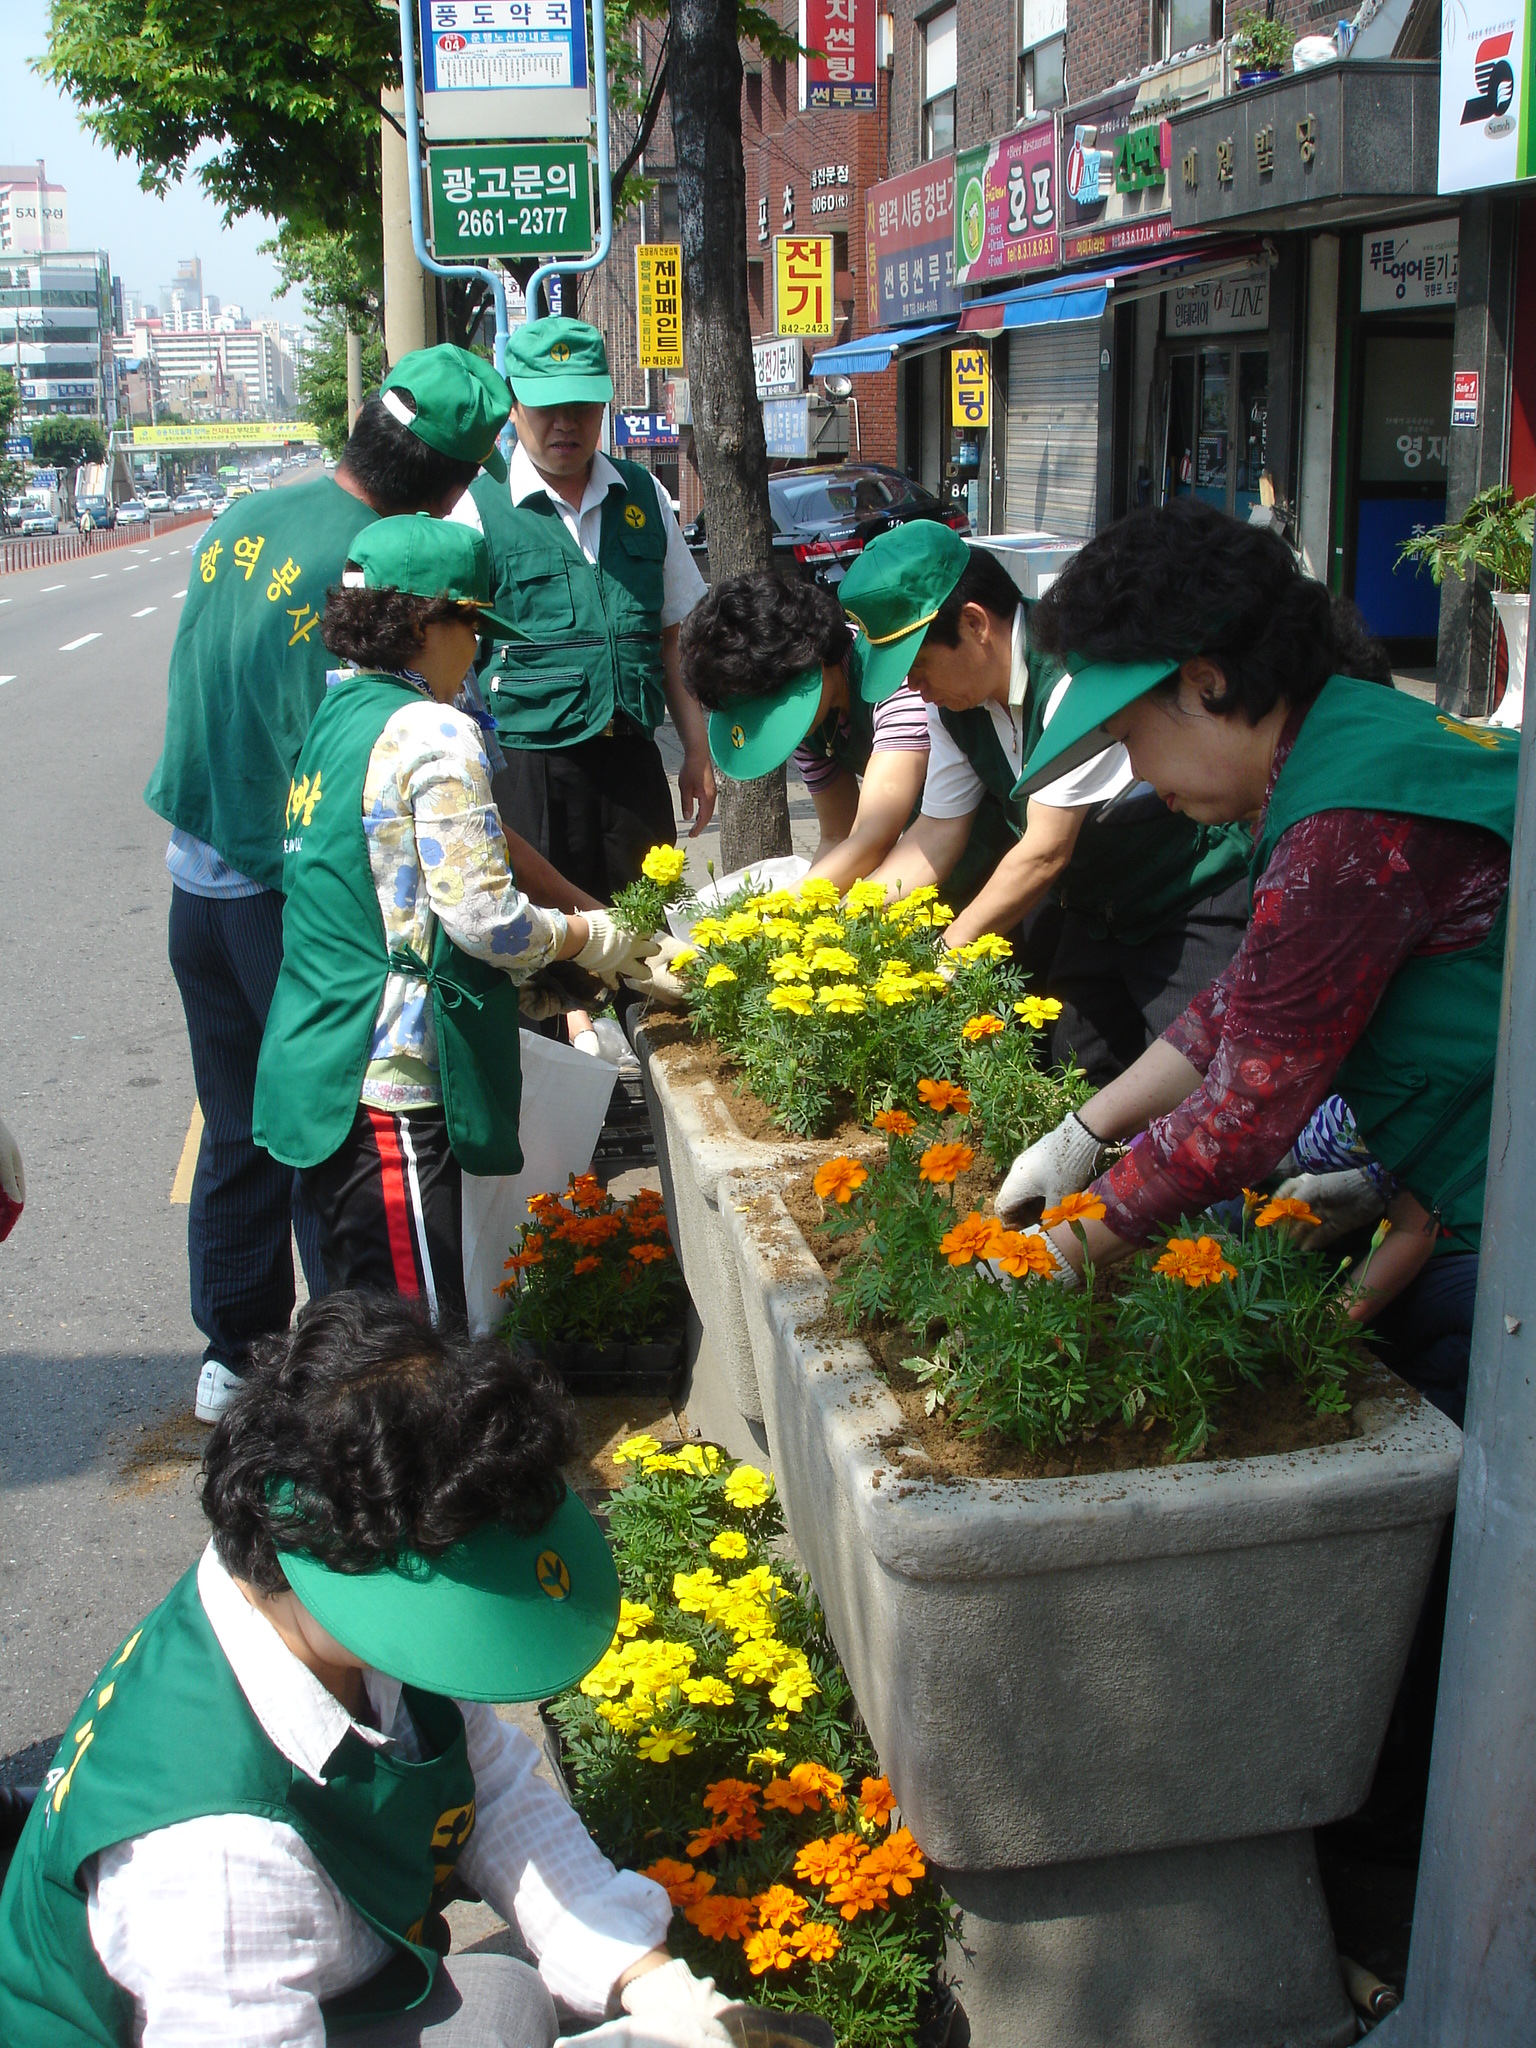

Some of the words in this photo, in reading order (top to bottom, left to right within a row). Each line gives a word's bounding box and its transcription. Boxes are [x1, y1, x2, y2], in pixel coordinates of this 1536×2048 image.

[444, 40, 460, 52] 04
[470, 31, 551, 44] 운행노선안내도
[810, 87, 874, 107] 썬루프
[1114, 124, 1167, 194] 간판
[441, 163, 577, 204] 광고문의
[1008, 165, 1054, 232] 호프
[15, 207, 37, 219] 5차
[42, 207, 64, 220] 우성
[457, 207, 568, 237] 2661-2377
[879, 197, 898, 237] 원격
[901, 188, 922, 228] 시동
[867, 201, 878, 316] 자동차
[1370, 240, 1394, 275] 푸른
[785, 241, 823, 324] 전기
[1391, 259, 1422, 299] 영어
[655, 260, 679, 352] 제비페인트
[1175, 301, 1209, 328] 인테리어
[1230, 284, 1267, 318] LINE
[781, 324, 829, 334] 842-2423
[955, 355, 985, 421] 썬팅
[627, 436, 679, 444] 849-4337
